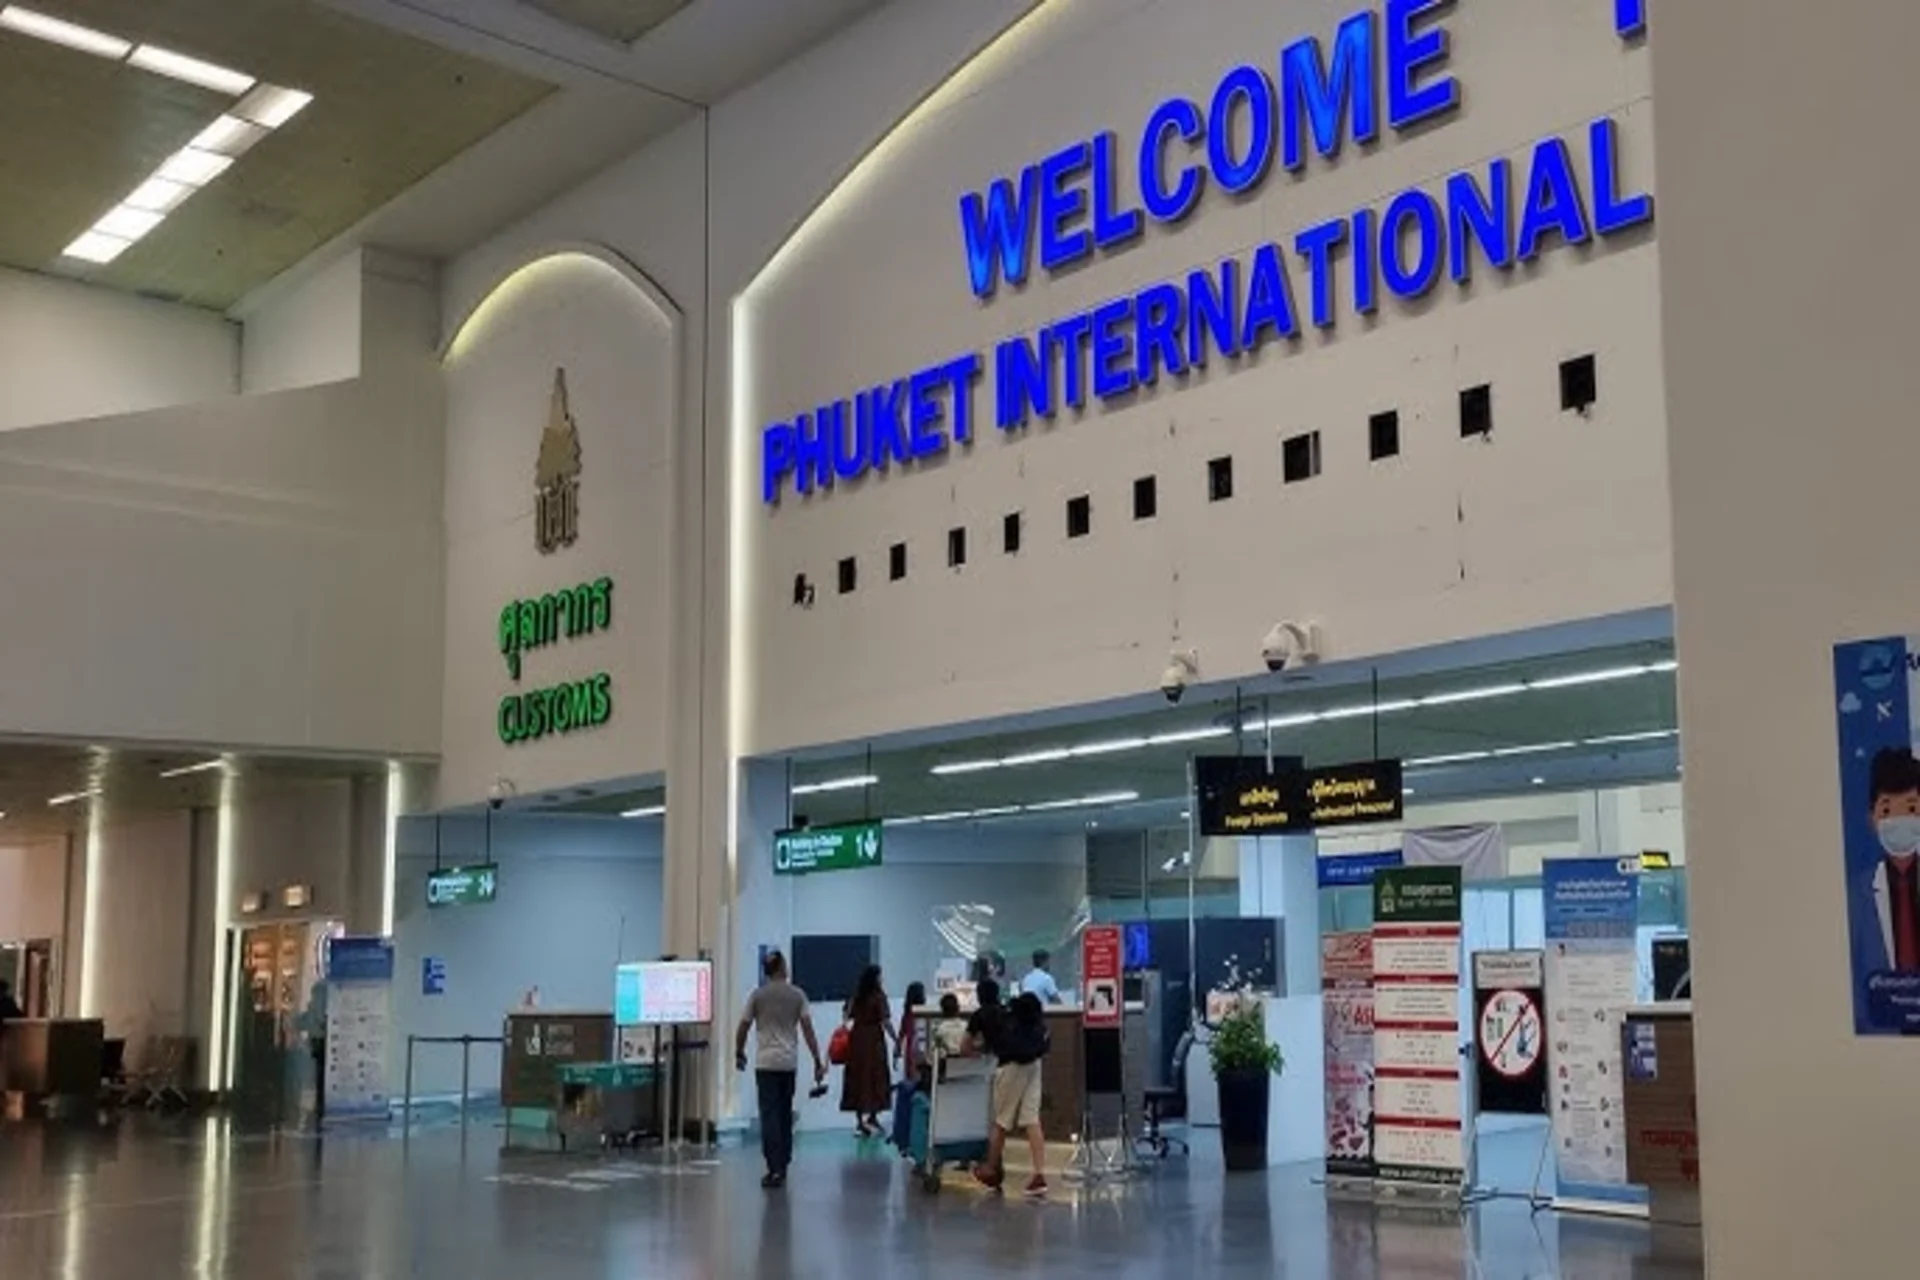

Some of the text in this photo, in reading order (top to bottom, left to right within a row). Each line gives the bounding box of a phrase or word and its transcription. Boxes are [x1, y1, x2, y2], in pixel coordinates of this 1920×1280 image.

[959, 0, 1461, 300] WELCOME
[763, 118, 1654, 505] PHUKET INTERNATIONAL
[499, 577, 613, 680] ศุลกากร
[499, 672, 611, 744] CUSTOMS
